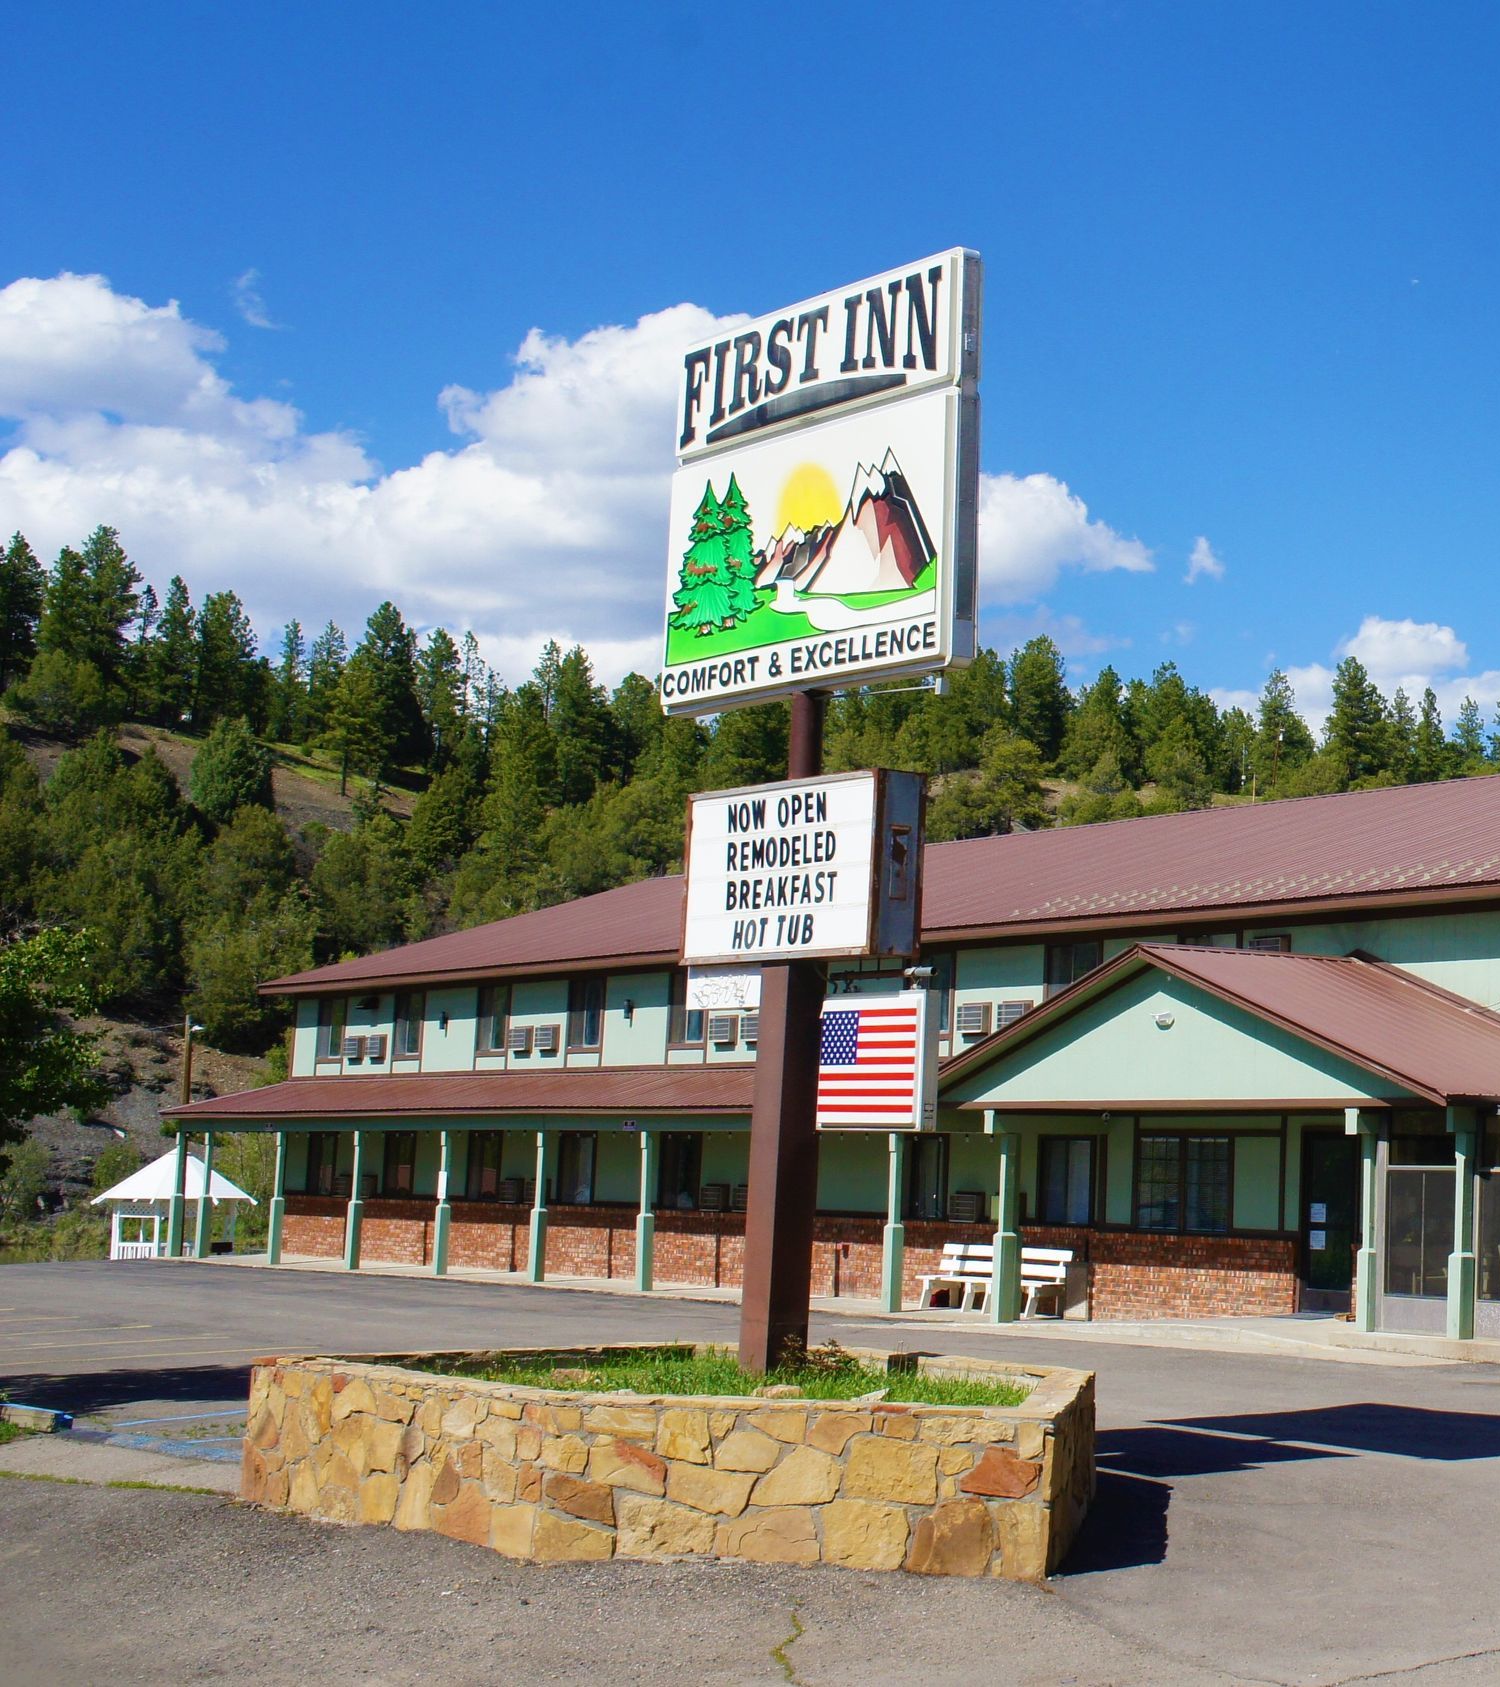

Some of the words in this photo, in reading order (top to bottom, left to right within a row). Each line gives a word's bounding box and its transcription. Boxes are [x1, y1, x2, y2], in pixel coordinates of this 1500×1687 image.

[680, 304, 829, 450] FIRST
[840, 265, 942, 372] INN
[663, 656, 759, 698] COMFORT
[769, 651, 783, 678] &
[791, 621, 935, 674] EXCELLENCE
[728, 800, 766, 833] NOW
[778, 792, 827, 828] OPEN
[727, 830, 836, 872] REMODELED
[726, 871, 838, 911] BREAKFAST
[732, 917, 768, 949] HOT
[777, 914, 814, 947] TUB
